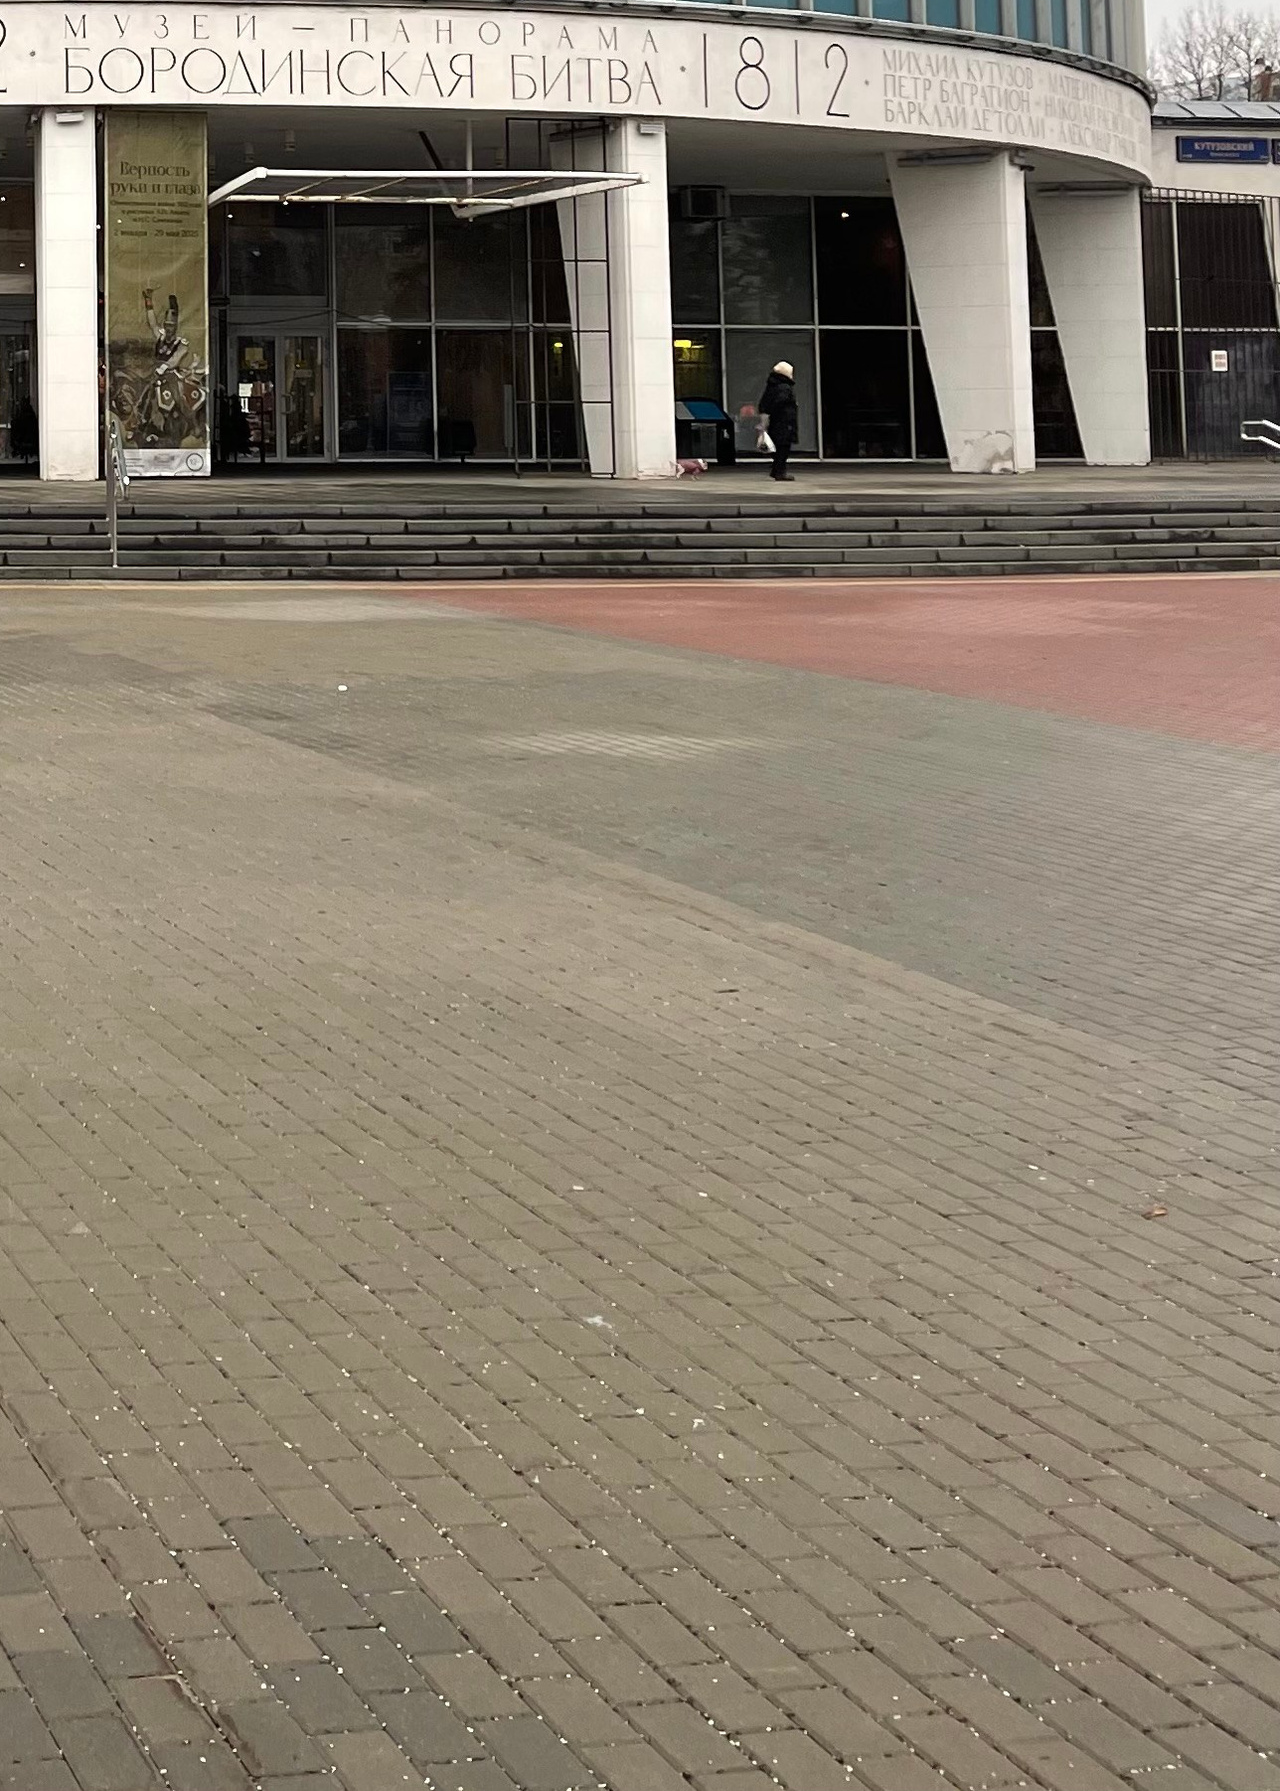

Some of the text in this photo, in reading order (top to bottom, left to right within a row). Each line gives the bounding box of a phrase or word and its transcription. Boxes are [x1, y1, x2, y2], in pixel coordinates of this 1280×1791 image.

[64, 47, 662, 105] БОРОДИНСКАЯ БИТВА
[703, 33, 850, 117] 1812
[882, 48, 960, 80] МИХАИЛ
[966, 58, 1034, 90] КУТУЗОВ
[883, 74, 932, 101] ПЕТР
[939, 79, 1031, 113] БАГРАТИОН
[971, 108, 993, 133] ДЕ
[993, 110, 1046, 139] ТОЛЛИ
[110, 182, 201, 197] руки и глаза
[120, 161, 191, 179] Верность
